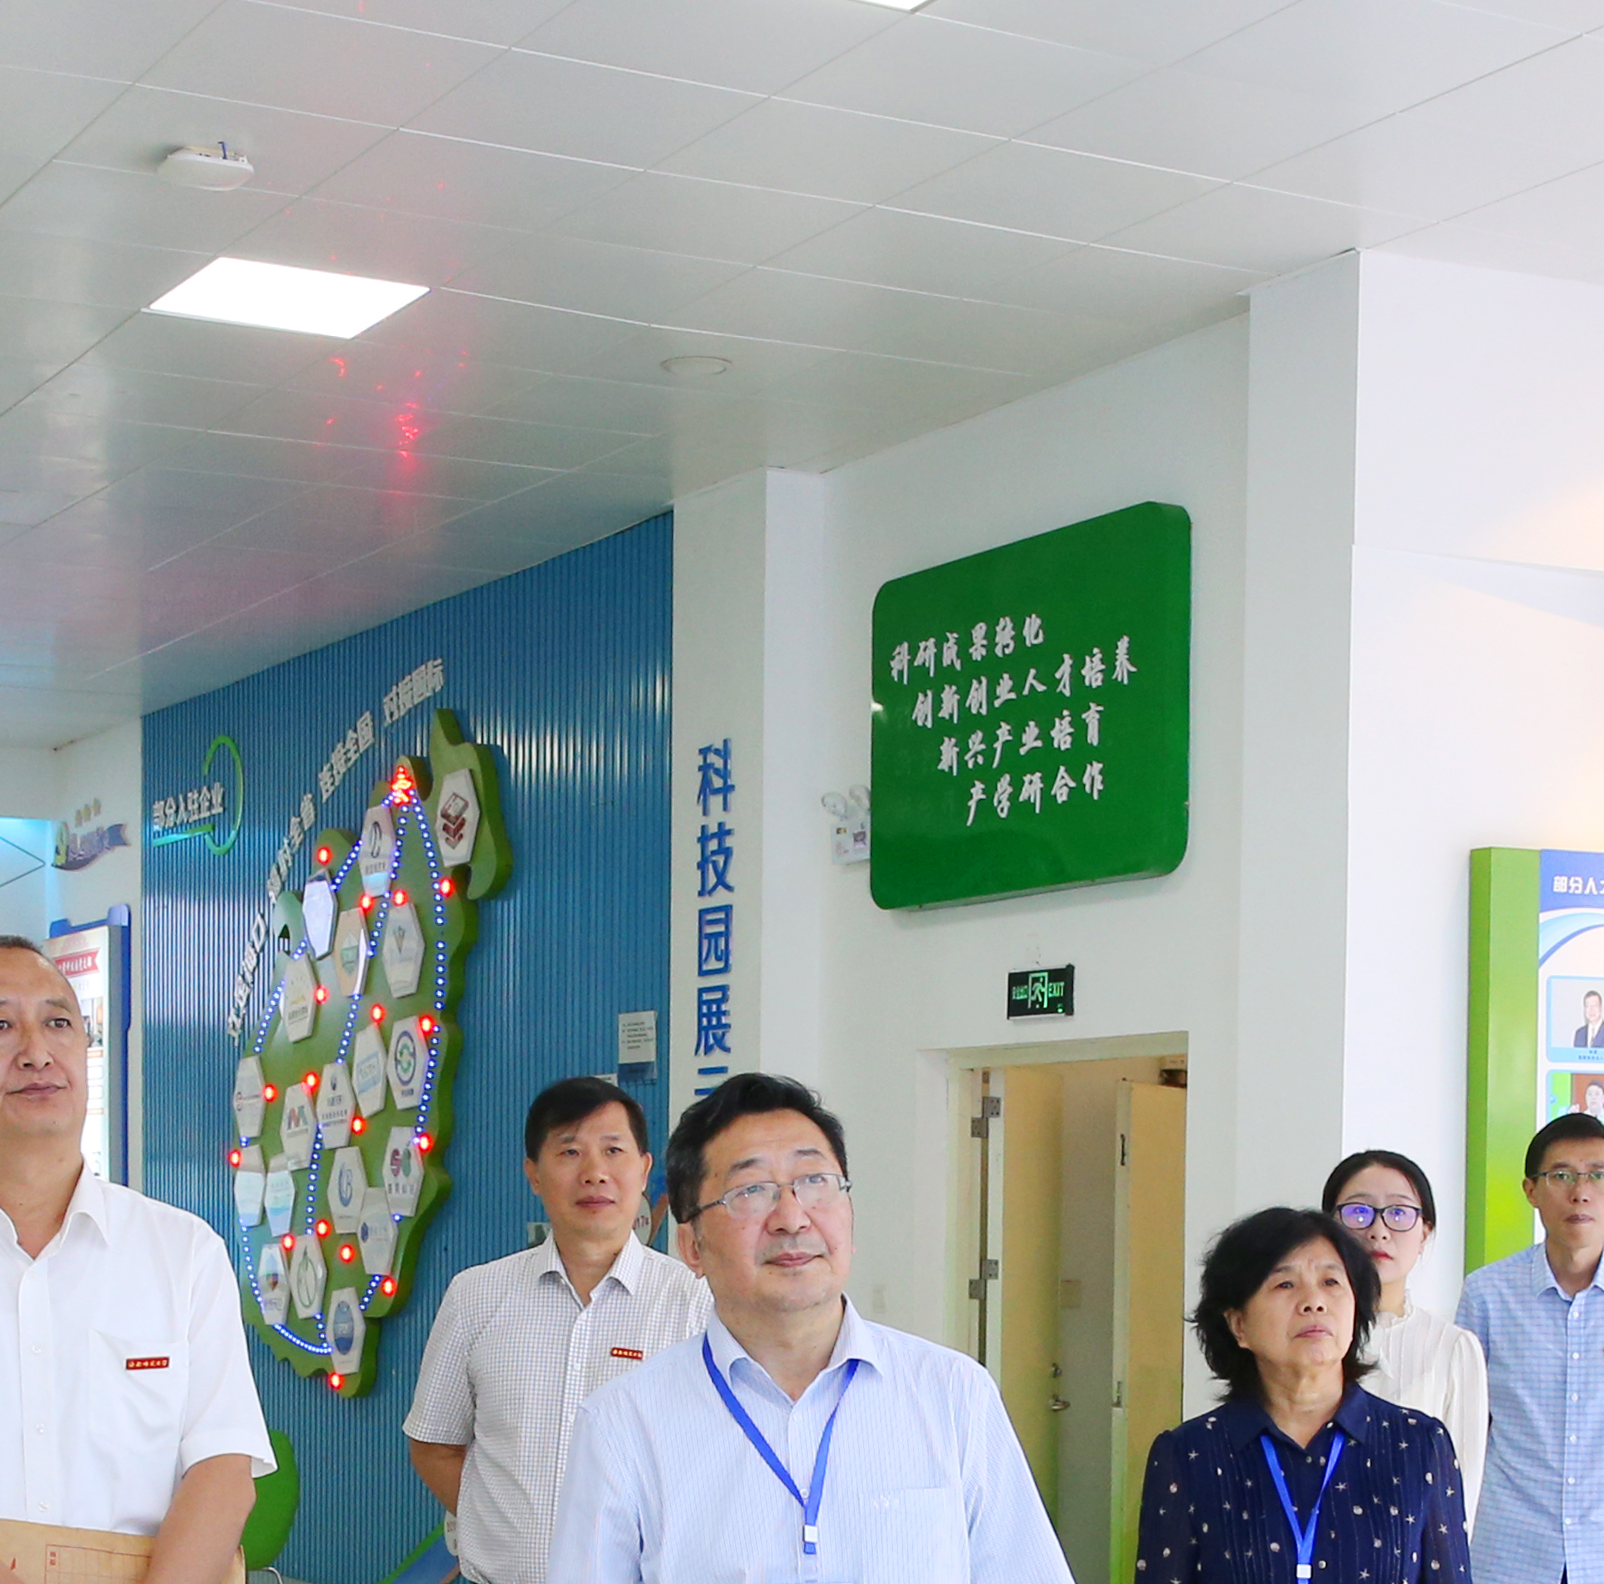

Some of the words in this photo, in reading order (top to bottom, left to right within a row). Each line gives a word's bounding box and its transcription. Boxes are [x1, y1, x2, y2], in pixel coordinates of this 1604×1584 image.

[889, 613, 1044, 685] 科研成果转化
[911, 635, 1137, 728] 创新创业人才培养
[937, 702, 1105, 776] 新兴产业培育
[966, 761, 1105, 827] 产学研合作
